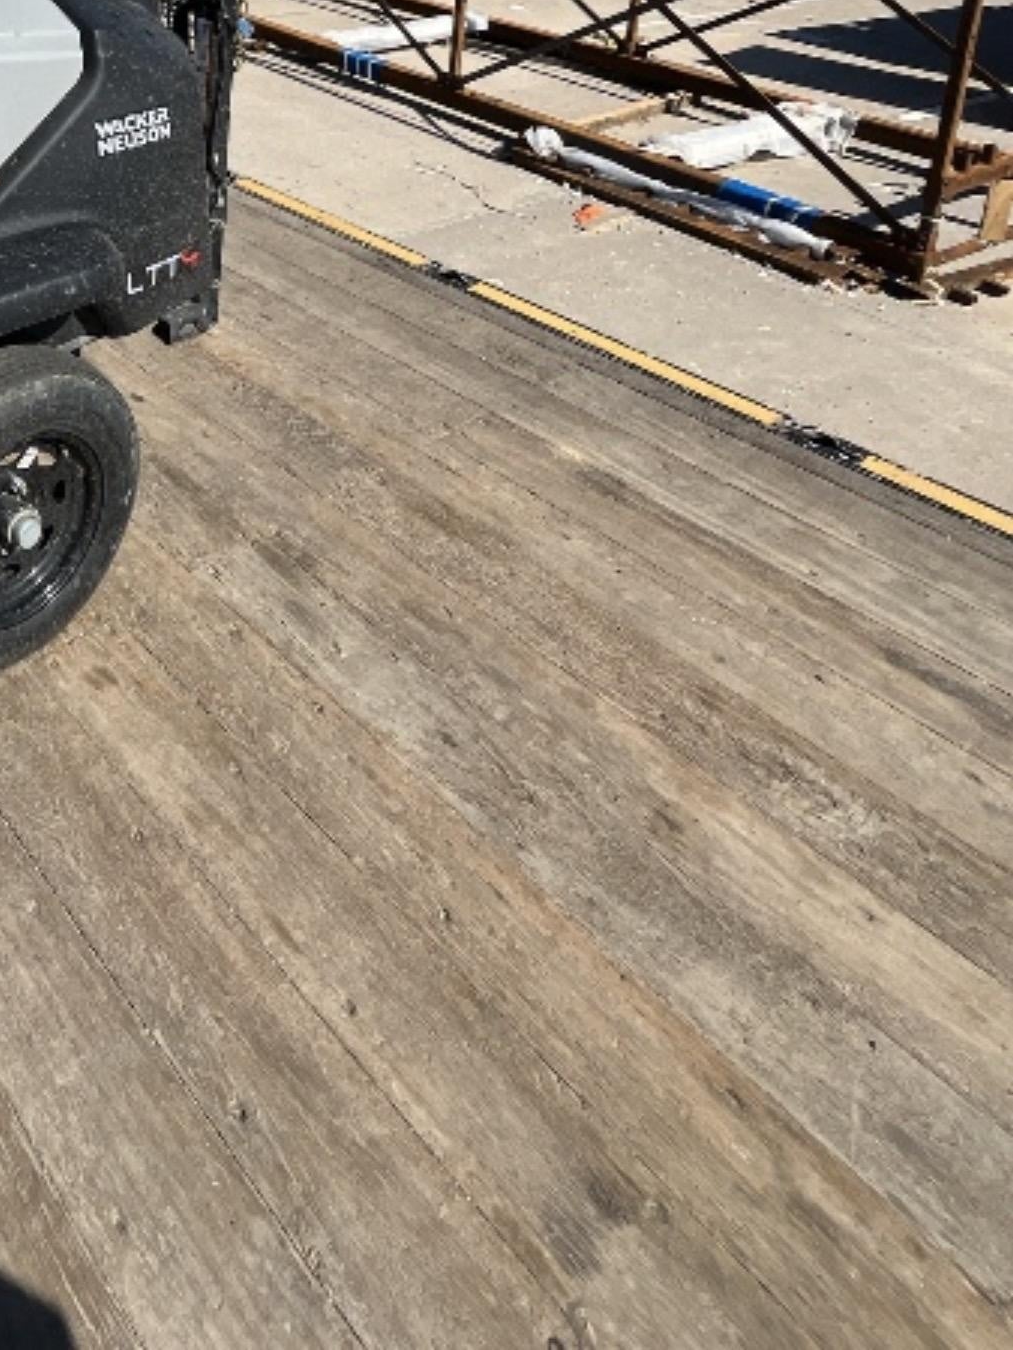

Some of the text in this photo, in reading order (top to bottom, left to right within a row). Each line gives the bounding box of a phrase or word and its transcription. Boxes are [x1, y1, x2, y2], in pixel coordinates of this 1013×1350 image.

[94, 107, 170, 139] WACKER
[97, 123, 172, 157] NEUSON
[127, 253, 180, 295] LTT
